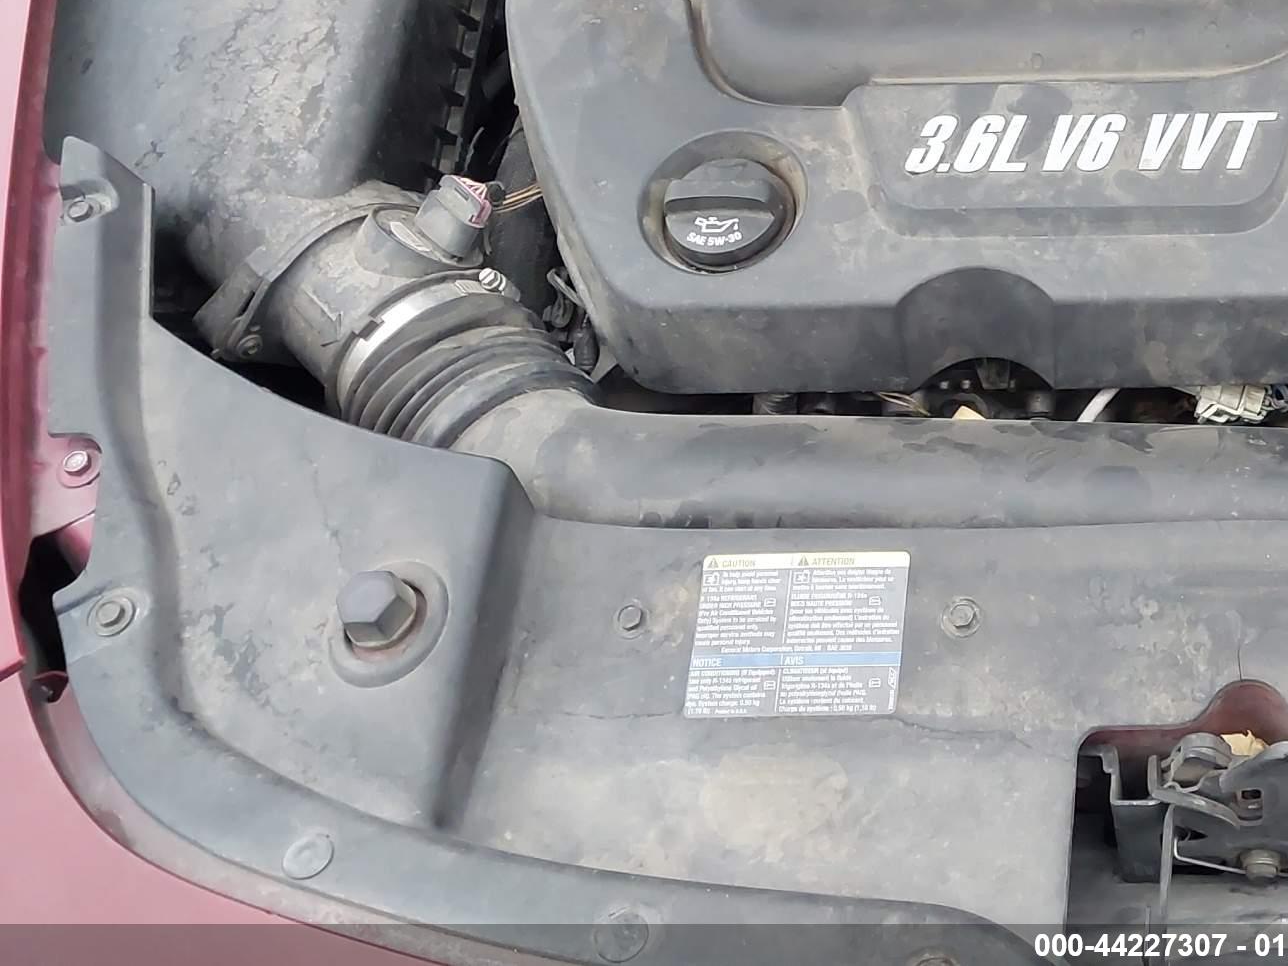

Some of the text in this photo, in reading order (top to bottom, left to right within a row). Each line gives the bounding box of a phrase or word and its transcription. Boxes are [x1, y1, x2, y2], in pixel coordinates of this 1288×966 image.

[904, 112, 1279, 174] 3.6L V6 VVT
[687, 232, 742, 246] SAE 5W-30
[722, 559, 756, 568] CAUTION
[812, 557, 855, 566] ATTENTION
[692, 657, 723, 667] NOTICE
[784, 656, 804, 666] AVIS
